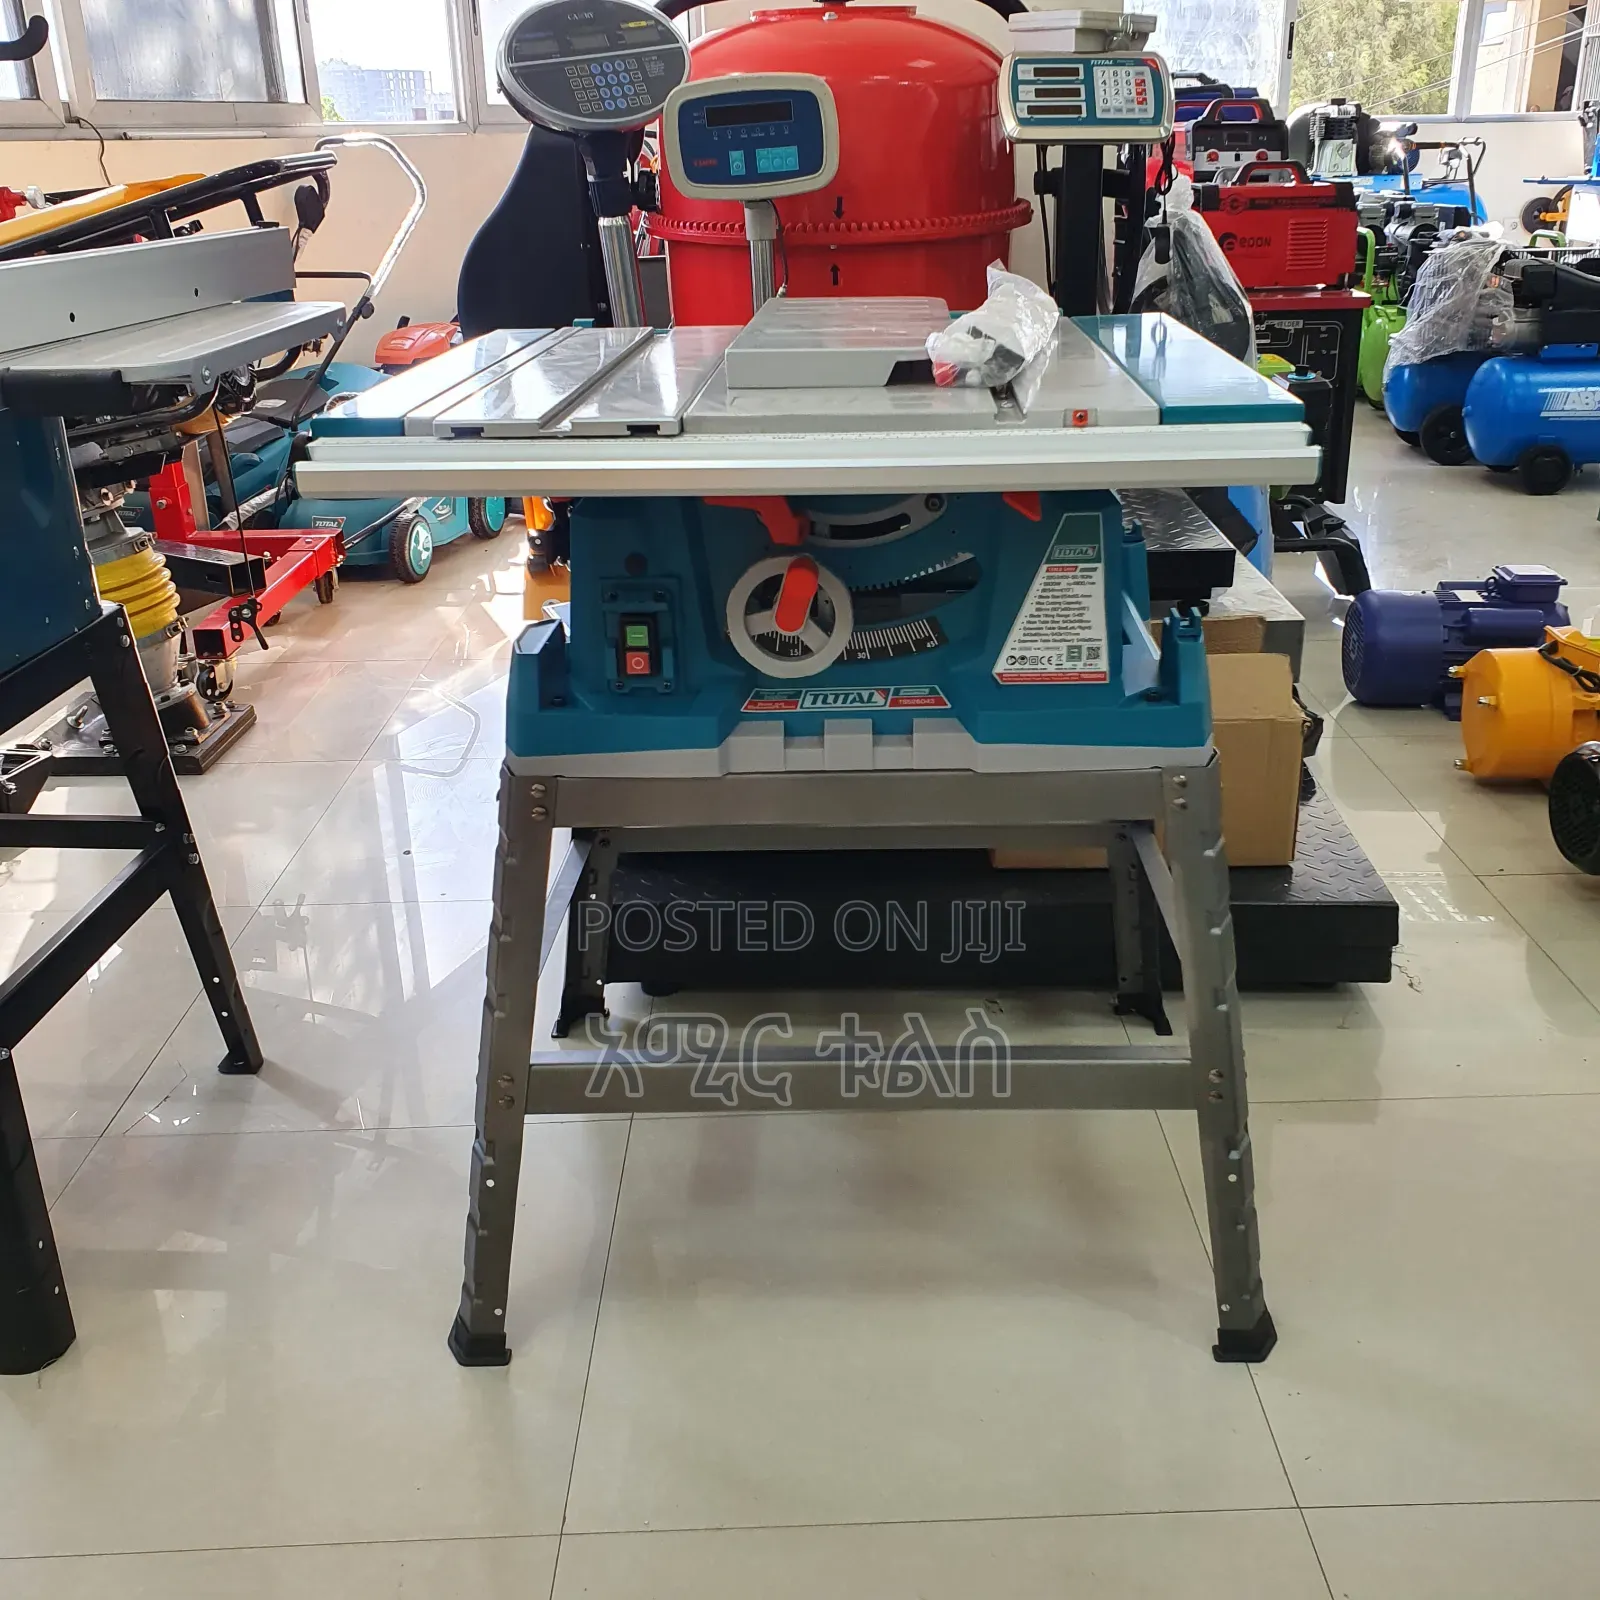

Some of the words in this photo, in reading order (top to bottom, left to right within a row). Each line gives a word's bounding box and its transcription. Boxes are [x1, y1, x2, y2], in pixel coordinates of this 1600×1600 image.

[315, 520, 339, 528] TOTAL
[1057, 547, 1091, 557] TOTAL
[926, 641, 936, 649] 45
[857, 651, 866, 660] 30
[808, 691, 880, 706] TOTAL
